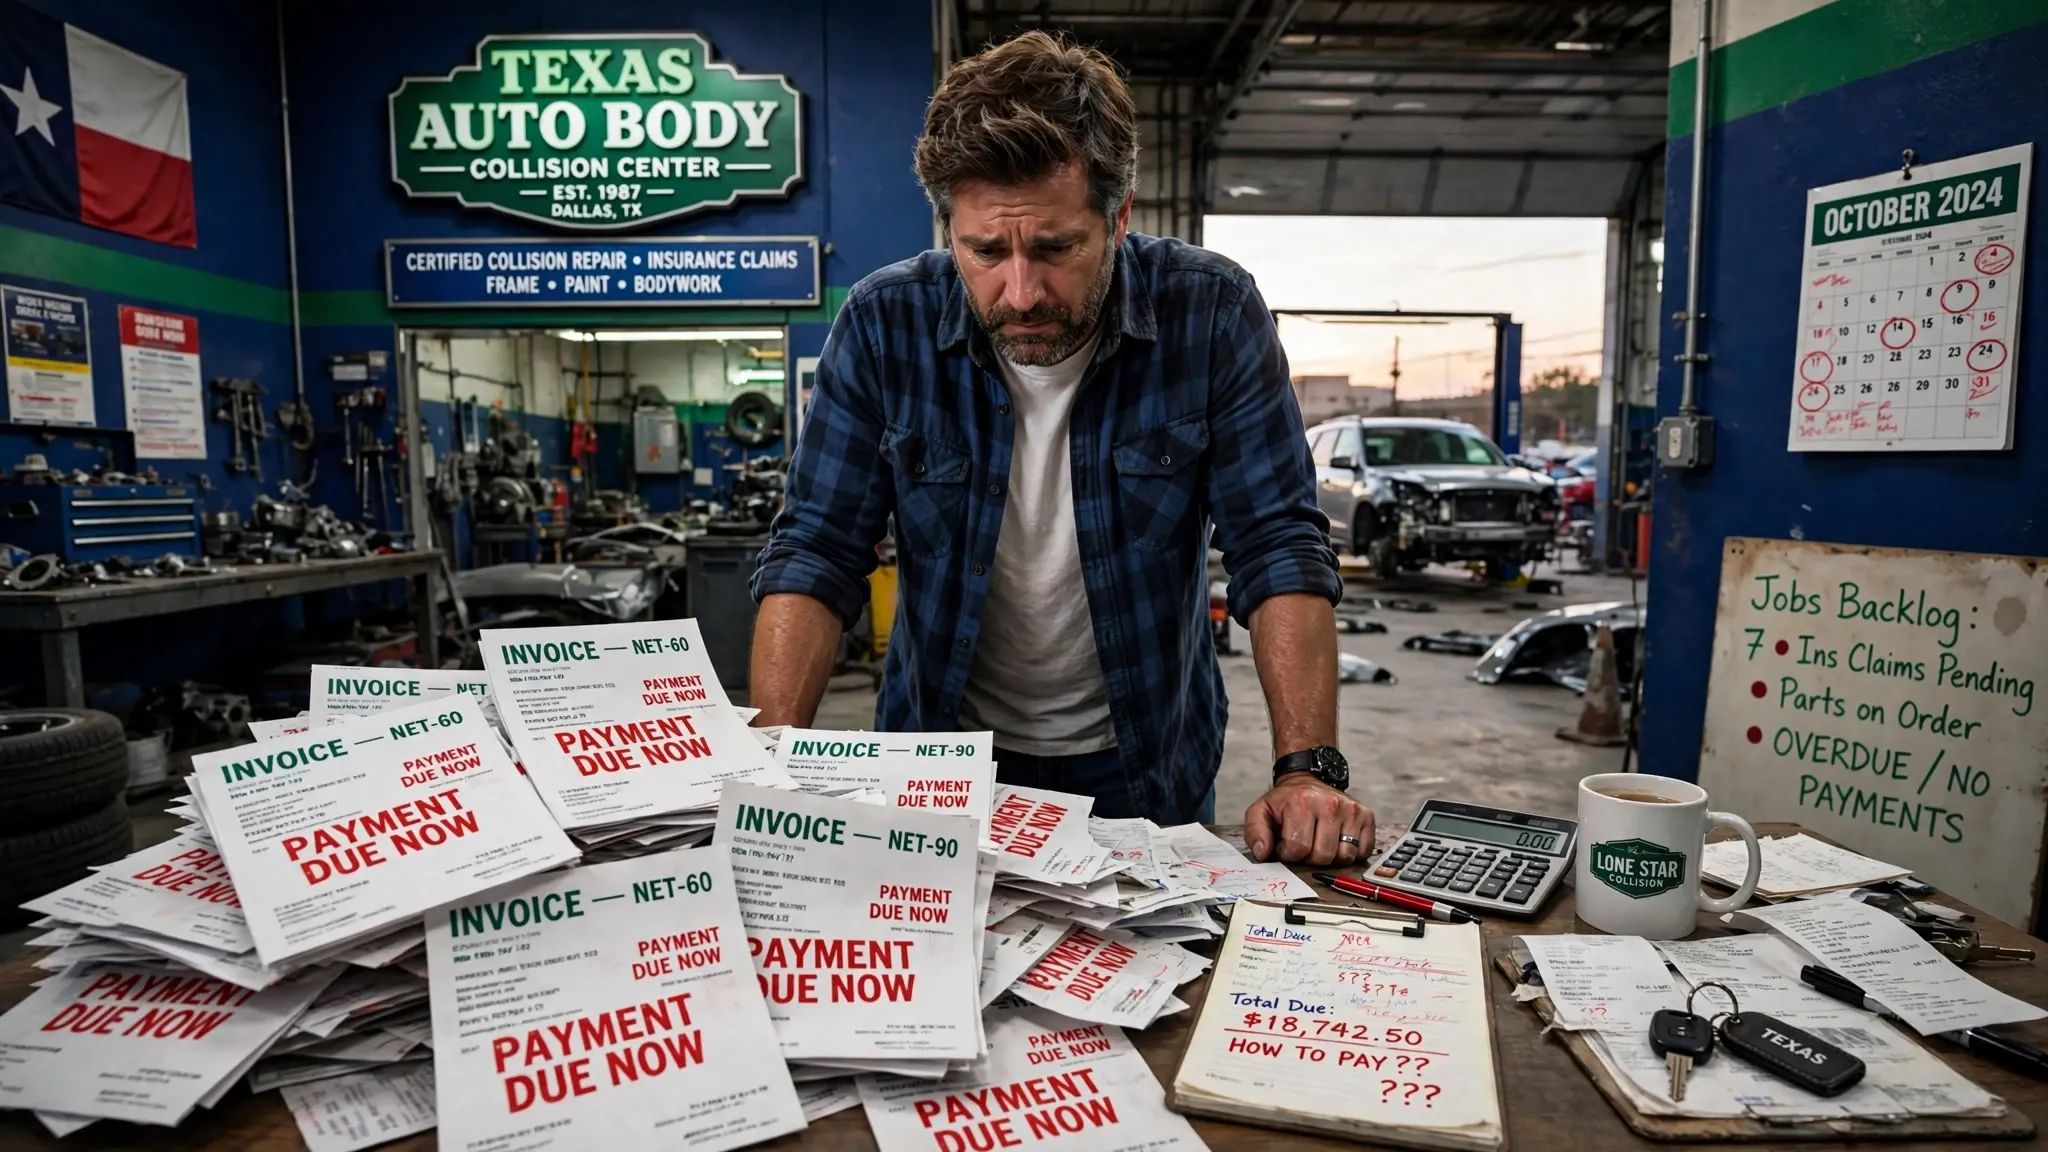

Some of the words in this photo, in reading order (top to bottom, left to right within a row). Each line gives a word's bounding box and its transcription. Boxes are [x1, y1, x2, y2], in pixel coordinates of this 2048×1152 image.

[491, 47, 694, 95] TEXAS
[409, 101, 586, 151] AUTO
[602, 100, 779, 149] BODY
[470, 157, 609, 179] COLLISION
[617, 156, 720, 178] CENTER
[553, 184, 592, 200] EST.
[598, 184, 641, 200] 1987
[1824, 191, 1930, 237] OCTOBER
[1937, 177, 2003, 218] 2024
[552, 203, 617, 220] DALLAS,
[621, 203, 642, 218] TX
[406, 252, 483, 272] CERTIFIED
[488, 252, 568, 271] COLLISION
[572, 251, 626, 270] REPAIR
[648, 251, 736, 270] INSURANCE
[740, 250, 798, 269] CLAIMS
[1930, 257, 1933, 266] 1
[1958, 252, 1965, 262] 2
[486, 276, 540, 294] FRAME
[564, 276, 610, 294] PAINT
[634, 275, 722, 293] BODYWORK
[1844, 298, 1848, 307] 5
[1870, 294, 1876, 303] 6
[1897, 291, 1903, 301] 7
[1926, 288, 1932, 297] 8
[1957, 284, 1962, 293] 9
[1866, 324, 1876, 334] 12
[1893, 322, 1903, 331] 14
[1921, 318, 1933, 328] 15
[1952, 314, 1963, 324] 16
[1918, 350, 1931, 360] 23
[1948, 347, 1961, 357] 23
[1978, 344, 1992, 355] 24
[1834, 385, 1845, 394] 25
[1861, 383, 1872, 392] 26
[1945, 378, 1959, 389] 30
[1751, 574, 1822, 615] Jobs
[501, 640, 600, 665] INVOICE
[631, 636, 690, 655] NET-60
[327, 678, 421, 696] INVOICE
[643, 675, 702, 691] PAYMENT
[1744, 628, 1765, 661] 7
[1796, 635, 1838, 668] Ins
[1848, 642, 1925, 682] Claims
[1936, 653, 2035, 717] Pending
[642, 692, 672, 706] DUE
[674, 688, 707, 703] NOW
[1779, 676, 1845, 717] Parts
[1857, 702, 1885, 724] on
[1897, 700, 1982, 740] Order
[220, 739, 349, 784] INVOICE
[389, 710, 464, 741] NET-60
[554, 715, 698, 754] PAYMENT
[791, 740, 881, 758] INVOICE
[916, 744, 975, 757] NET-90
[400, 770, 438, 788] DUE
[442, 756, 482, 780] NOW
[403, 743, 478, 773] PAYMENT
[571, 748, 641, 777] DUE
[640, 737, 713, 766] NOW
[1773, 727, 1912, 780] OVERDUE
[1947, 764, 1991, 797] NO
[897, 794, 928, 808] DUE
[932, 795, 969, 808] NOW
[907, 780, 972, 793] PAYMENT
[990, 793, 1036, 845] AYMENT
[1025, 802, 1068, 832] NOW
[1799, 774, 1965, 844] PAYMENTS
[282, 788, 465, 862] PAYMENT
[735, 803, 847, 846] INVOICE
[888, 829, 959, 859] NET-90
[300, 841, 387, 887] DUE
[390, 810, 480, 857] NOW
[1004, 828, 1050, 858] DUE
[1516, 831, 1556, 850] 0.00
[132, 864, 208, 892] DUE
[1597, 852, 1635, 875] LONE
[1640, 860, 1678, 878] STAR
[880, 884, 952, 905] PAYMENT
[1609, 874, 1663, 887] COLLISION
[448, 889, 585, 938] INVOICE
[632, 871, 713, 904] NET-60
[869, 902, 907, 922] DUE
[909, 906, 949, 924] NOW
[637, 926, 720, 957] PAYMENT
[1246, 924, 1277, 938] Total
[632, 958, 673, 981] DUE
[678, 946, 722, 971] NOW
[1065, 966, 1112, 1001] DUE
[1090, 940, 1138, 973] NOW
[78, 972, 256, 1007] PAYMENT
[831, 973, 915, 1003] NOW
[1229, 992, 1279, 1009] Total
[1288, 999, 1334, 1015] Due:
[40, 1002, 139, 1035] DUE
[122, 1007, 235, 1040] NOW
[491, 992, 697, 1075] PAYMENT
[1028, 1024, 1106, 1048] PAYMENT
[1243, 1012, 1423, 1046] $18,742.50
[1026, 1048, 1067, 1065] DUE
[1068, 1038, 1111, 1057] NOW
[1228, 1037, 1283, 1058] HOW
[1295, 1045, 1326, 1062] TO
[1338, 1050, 1388, 1072] PAY
[1761, 1028, 1827, 1065] TEXAS
[504, 1057, 597, 1114] DUE
[606, 1029, 705, 1087] NOW
[914, 1067, 1099, 1129] PAYMENT
[933, 1118, 1023, 1152] DUE
[1024, 1096, 1120, 1141] NOW
